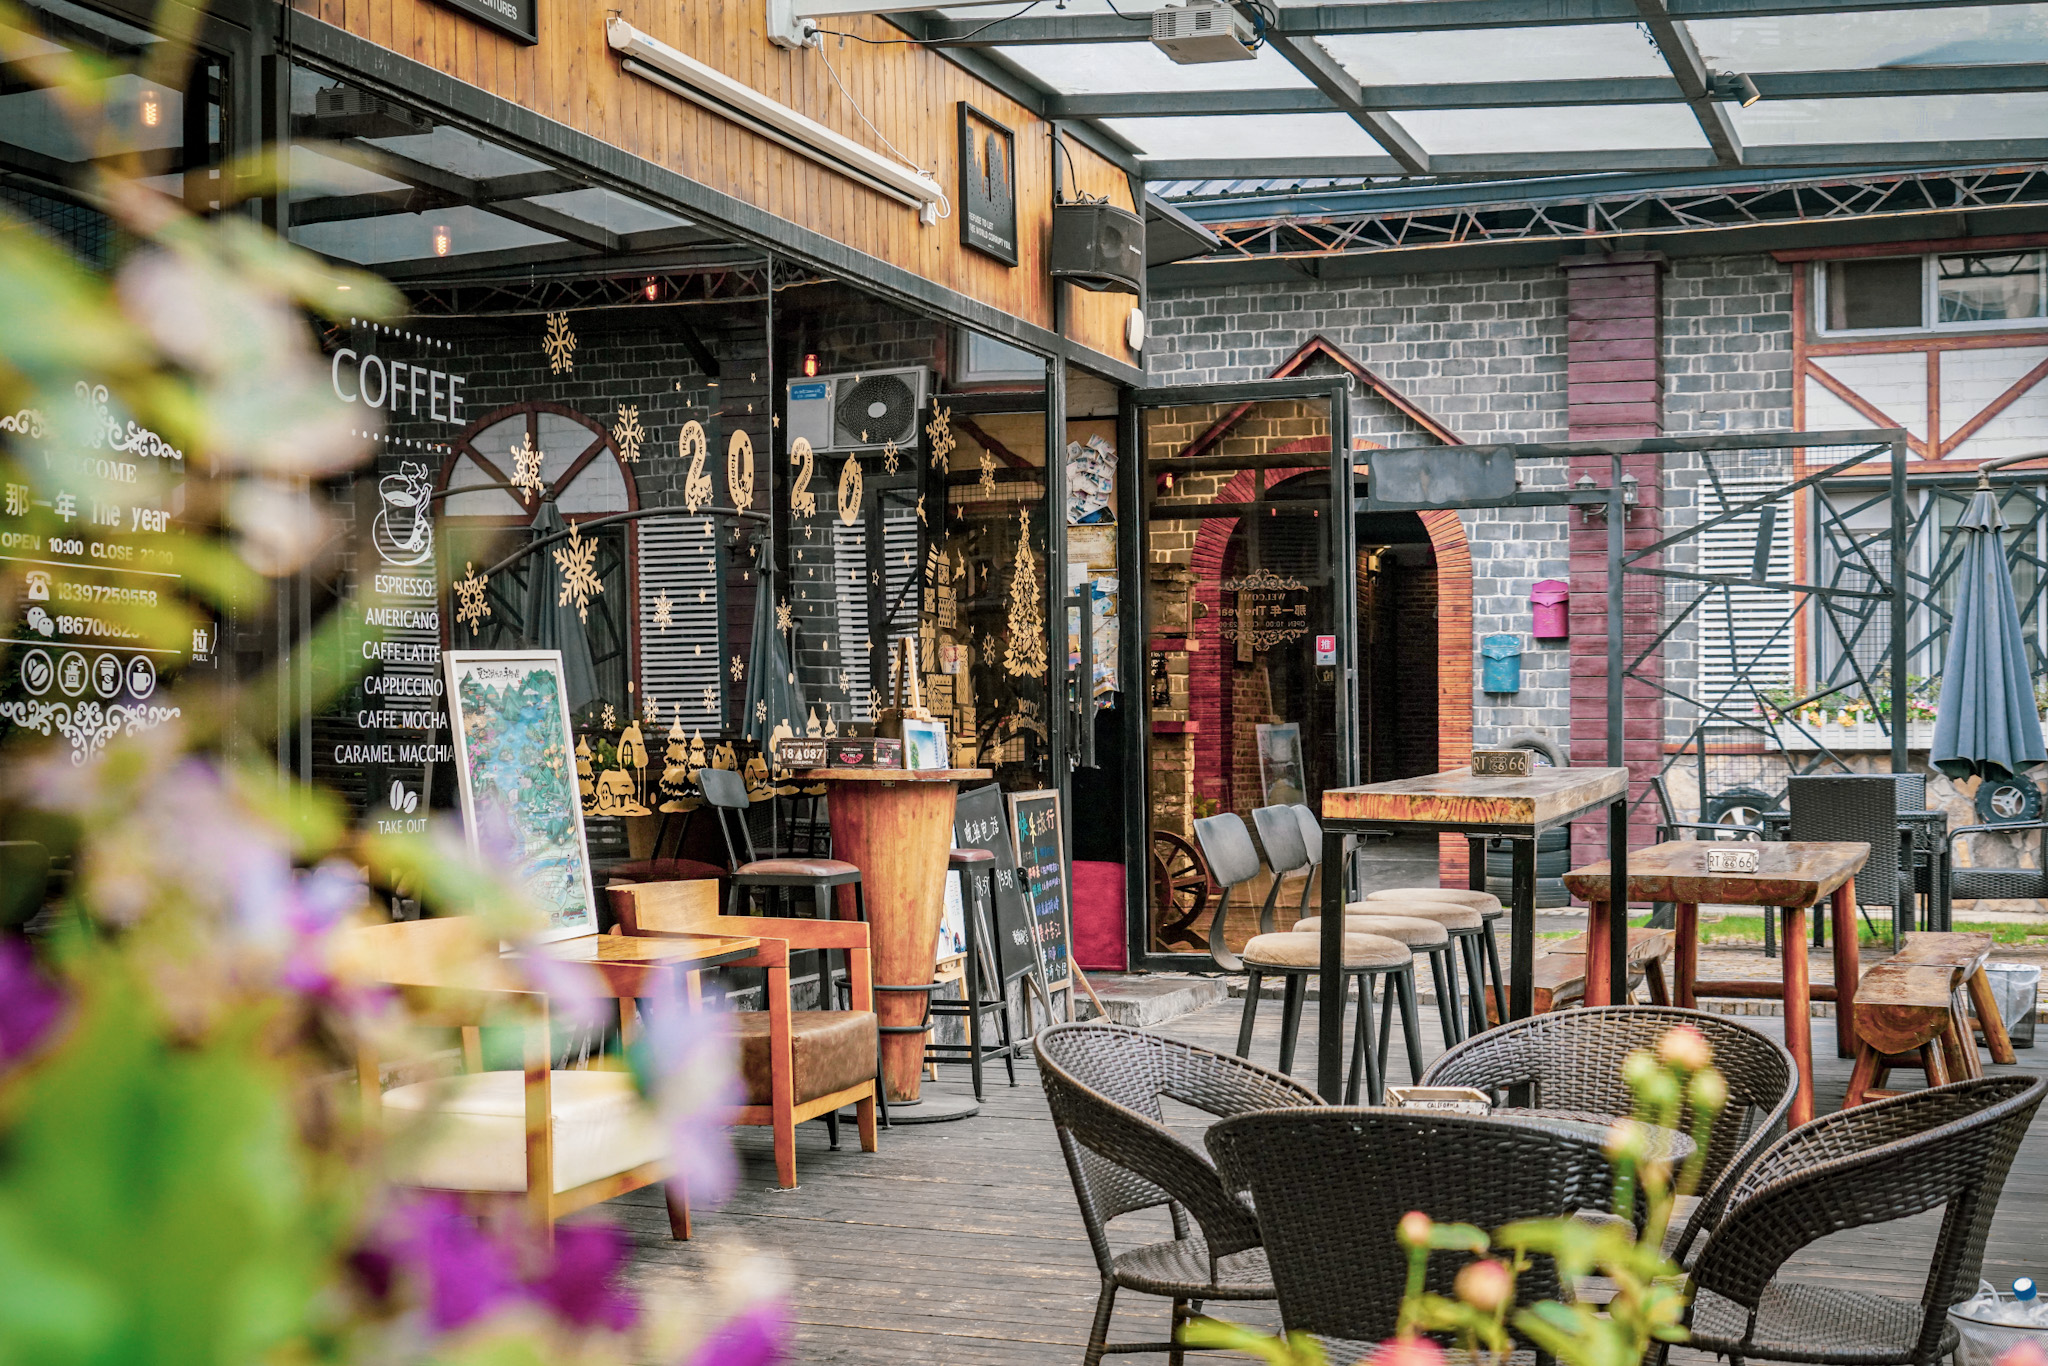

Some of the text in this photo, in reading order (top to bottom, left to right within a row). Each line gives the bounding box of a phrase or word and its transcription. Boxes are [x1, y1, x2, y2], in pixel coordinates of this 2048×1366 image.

[479, 0, 517, 20] NTURES
[968, 211, 982, 225] REFUSE
[332, 348, 466, 426] COFFEE
[43, 450, 138, 484] WLCOME
[5, 482, 171, 533] 那一年 The year
[1, 531, 41, 551] OPEN
[48, 536, 84, 556] 10:00
[90, 541, 134, 562] CLOSE
[58, 582, 158, 608] 18397259558
[375, 574, 432, 597] ESPRESSO
[56, 614, 145, 640] 18670082
[365, 607, 439, 630] AMERICANO
[192, 628, 208, 652] 拉
[1320, 639, 1332, 650] 推
[192, 653, 208, 662] PULL
[362, 641, 441, 663] CAFFE LATTE
[364, 675, 443, 697] CAPPUCCINO
[402, 710, 448, 730] MOCHA
[334, 744, 456, 764] CARAMEL MACCHIA
[1473, 756, 1487, 771] RT
[1509, 756, 1525, 771] 66
[378, 818, 427, 835] TAKE OUT
[1709, 855, 1720, 867] RT
[1738, 856, 1752, 868] 66
